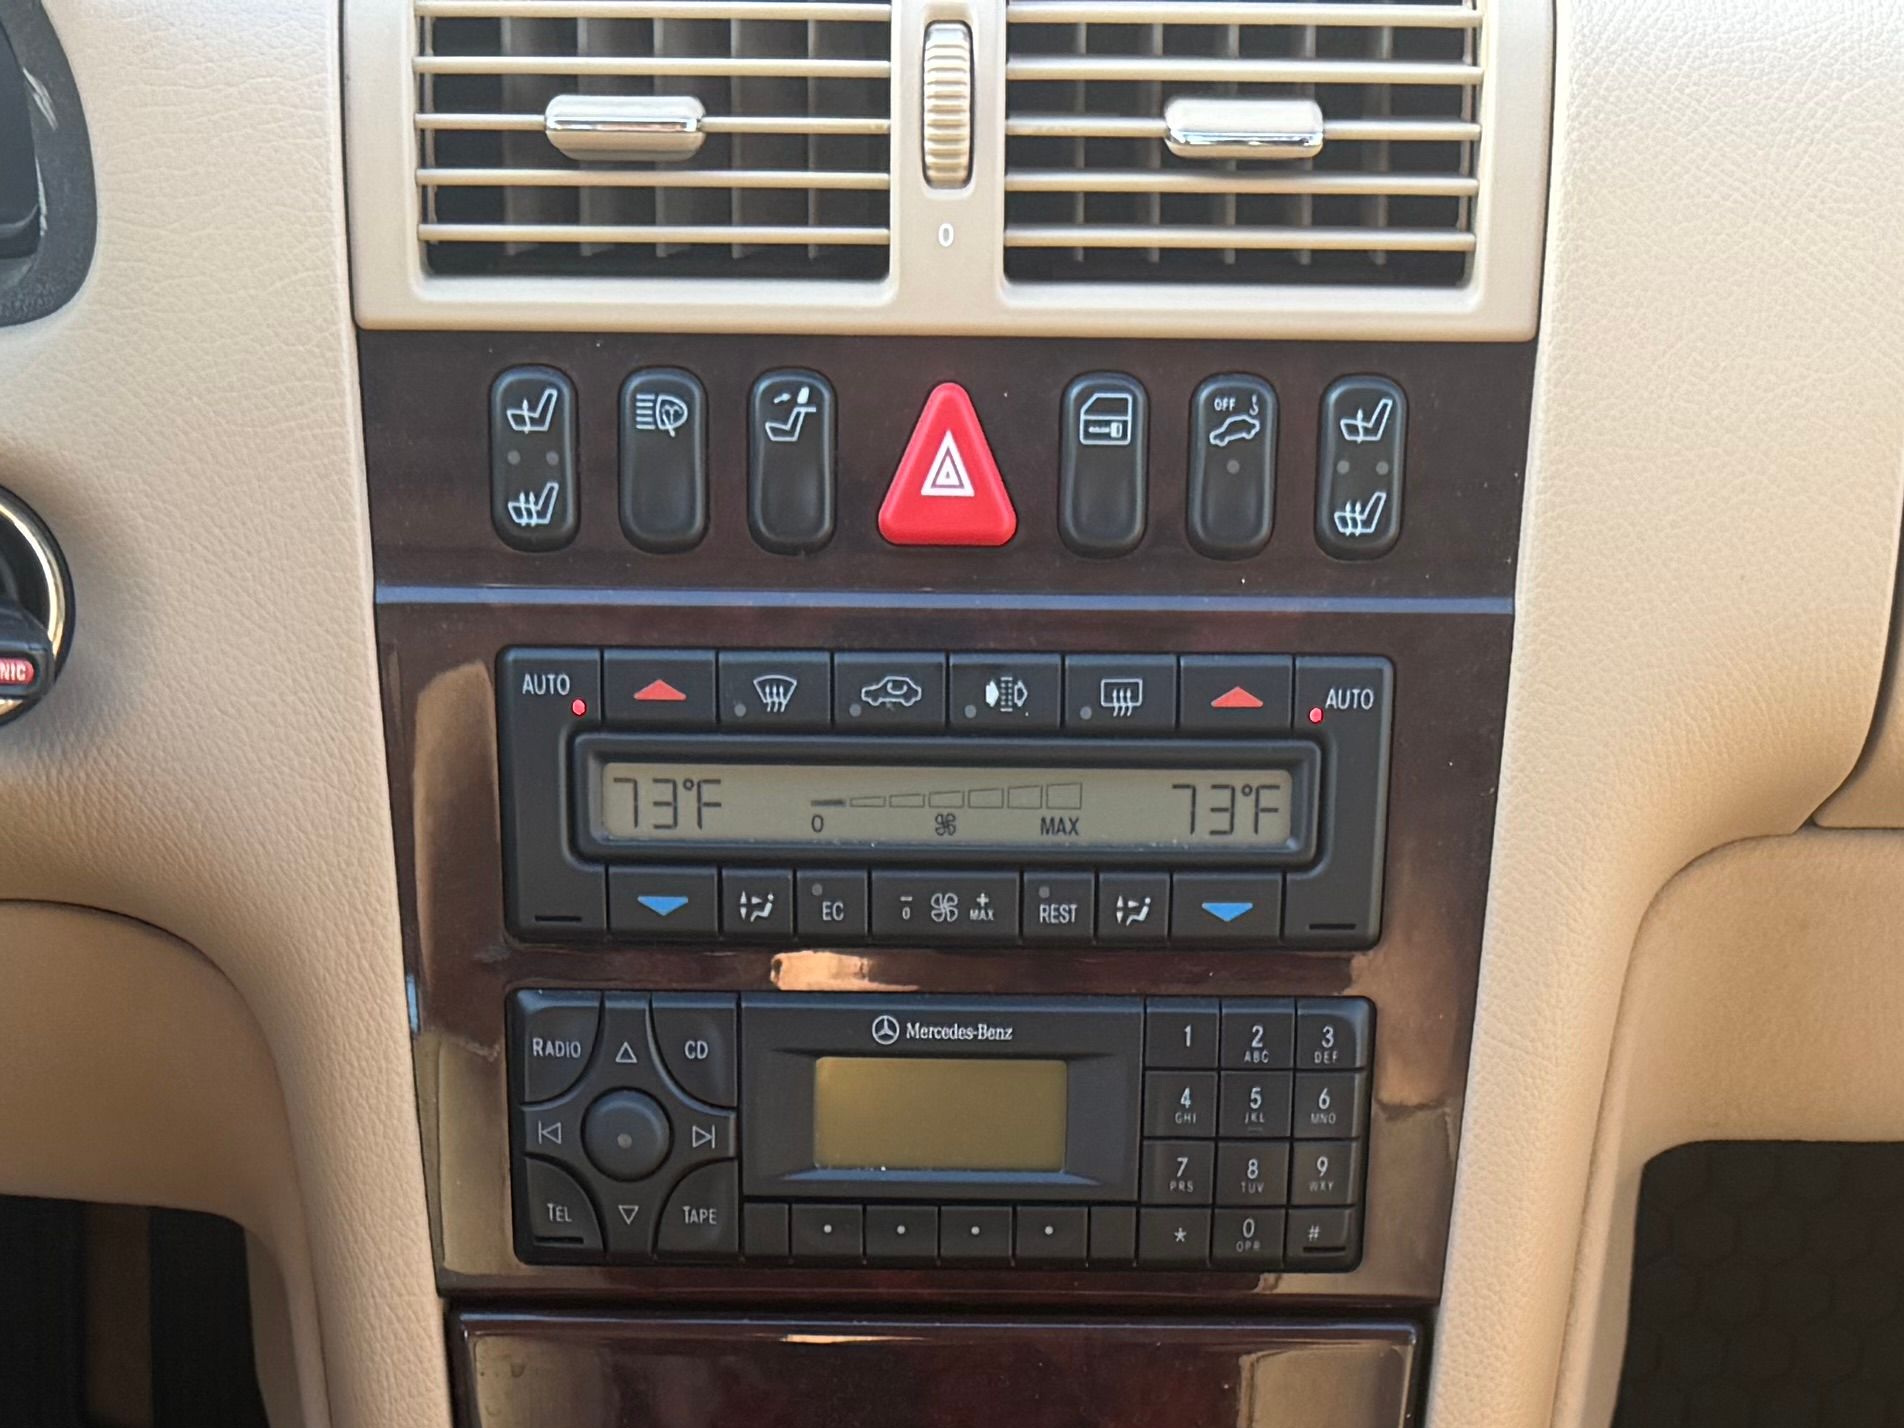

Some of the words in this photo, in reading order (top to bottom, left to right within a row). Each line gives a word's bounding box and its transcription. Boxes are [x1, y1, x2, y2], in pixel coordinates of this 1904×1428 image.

[1213, 396, 1236, 412] OFF
[522, 673, 571, 696] AUTO
[1325, 688, 1375, 710] AUTO
[612, 776, 723, 831] 73°F
[1171, 783, 1282, 836] 73°F
[1040, 816, 1080, 836] MAX
[822, 901, 844, 921] EC
[969, 908, 995, 921] MAX
[1039, 904, 1078, 924] REST
[906, 1022, 1013, 1041] Mercedes-Benz
[1183, 1024, 1192, 1048] 1
[1250, 1024, 1264, 1048] 2
[1321, 1026, 1335, 1049] 3
[531, 1037, 582, 1059] RADIO
[684, 1040, 709, 1060] CD
[1244, 1051, 1270, 1064] ABC
[1313, 1051, 1339, 1065] DEF
[1180, 1087, 1192, 1109] 4
[1249, 1087, 1262, 1110] 5
[1318, 1087, 1331, 1110] 6
[1174, 1112, 1197, 1125] GHI
[1244, 1112, 1265, 1124] JKL
[1310, 1112, 1337, 1125] MNO
[1176, 1156, 1189, 1178] 7
[1247, 1158, 1259, 1180] 8
[1316, 1156, 1329, 1178] 9
[1169, 1180, 1194, 1193] PRS
[1308, 1182, 1335, 1193] WXY
[546, 1202, 573, 1223] TEL
[682, 1205, 718, 1225] TAPE
[1242, 1217, 1256, 1239] 0
